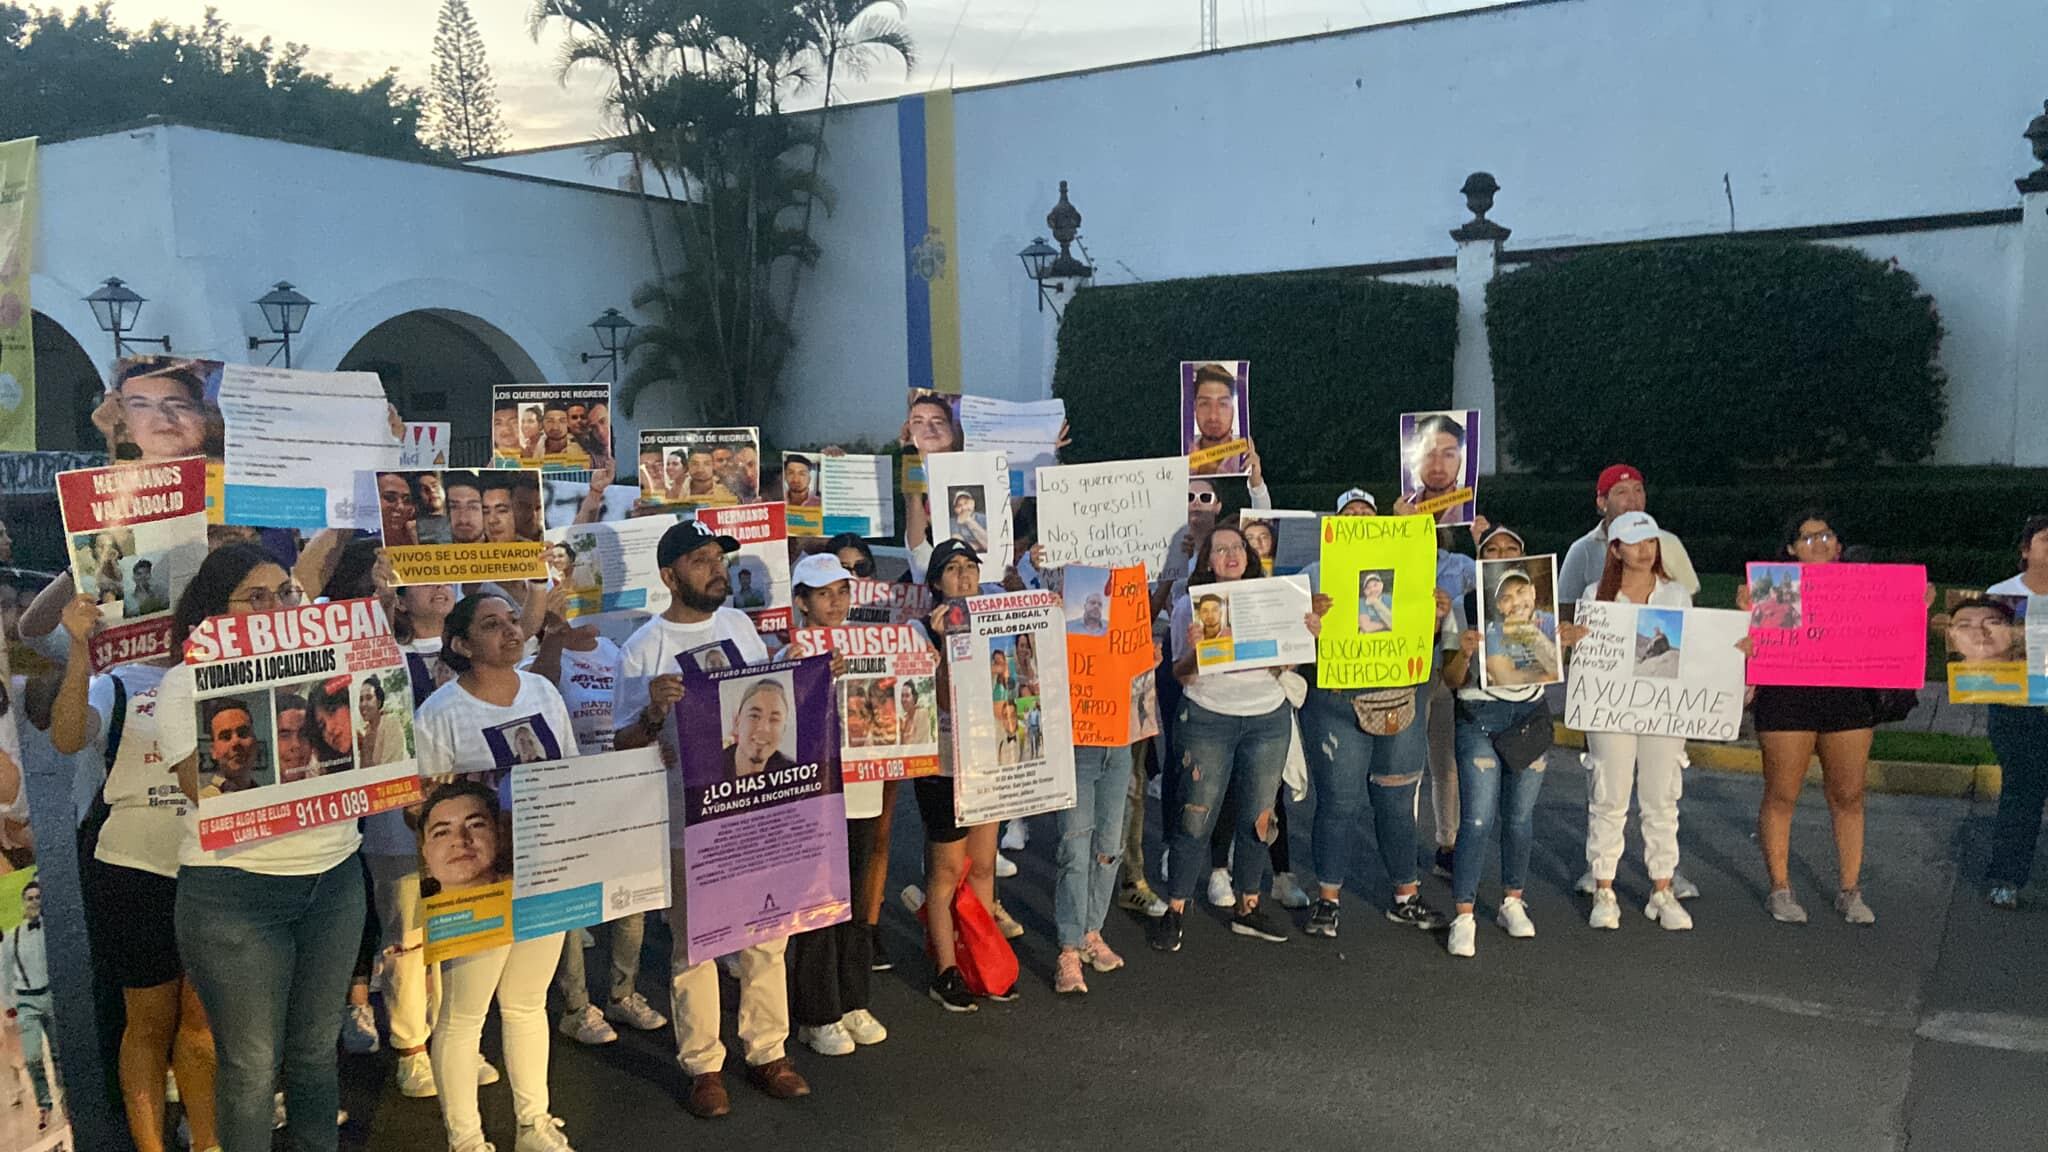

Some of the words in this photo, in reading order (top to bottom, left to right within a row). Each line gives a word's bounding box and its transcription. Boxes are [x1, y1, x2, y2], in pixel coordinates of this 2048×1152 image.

[494, 391, 511, 400] LOS
[512, 390, 560, 400] QUEREMOS
[561, 390, 571, 399] DE
[573, 390, 609, 398] REGRESO
[640, 435, 656, 444] LOS
[705, 433, 719, 442] DE
[719, 433, 754, 442] REGRES
[1040, 471, 1069, 493] Los
[1079, 470, 1145, 493] queremos
[1155, 466, 1174, 481] de
[716, 507, 769, 525] HERMANOS
[1047, 524, 1078, 546] Nos
[1424, 518, 1434, 536] A
[435, 552, 451, 561] SE
[454, 549, 478, 561] LOS
[443, 564, 467, 576] LOS
[968, 592, 1056, 612] DESAPARECIDOS
[977, 612, 1004, 624] ITZEL
[1005, 610, 1042, 620] ABIGAIL
[1042, 608, 1050, 617] Y
[979, 624, 1018, 636] CARLOS
[1018, 621, 1049, 630] DAVID
[189, 616, 243, 663] SE
[795, 629, 828, 658] SE
[1417, 636, 1426, 651] A
[255, 660, 265, 682] A
[265, 648, 336, 679] LOCALIZARLOS
[708, 668, 740, 680] ARTURO
[1073, 652, 1096, 677] DE
[1572, 675, 1734, 714] AYUDAME
[1568, 704, 1582, 728] A
[1590, 708, 1735, 740] ENCONTRARLO
[857, 762, 876, 780] 911
[702, 782, 732, 806] ¿LO
[735, 774, 767, 794] HAS
[768, 762, 819, 787] VISTO?
[296, 798, 325, 827] 911
[341, 789, 369, 817] 089
[701, 798, 751, 817] AYÚDANOS
[752, 796, 760, 805] A
[761, 782, 822, 803] ENCONTRARLO
